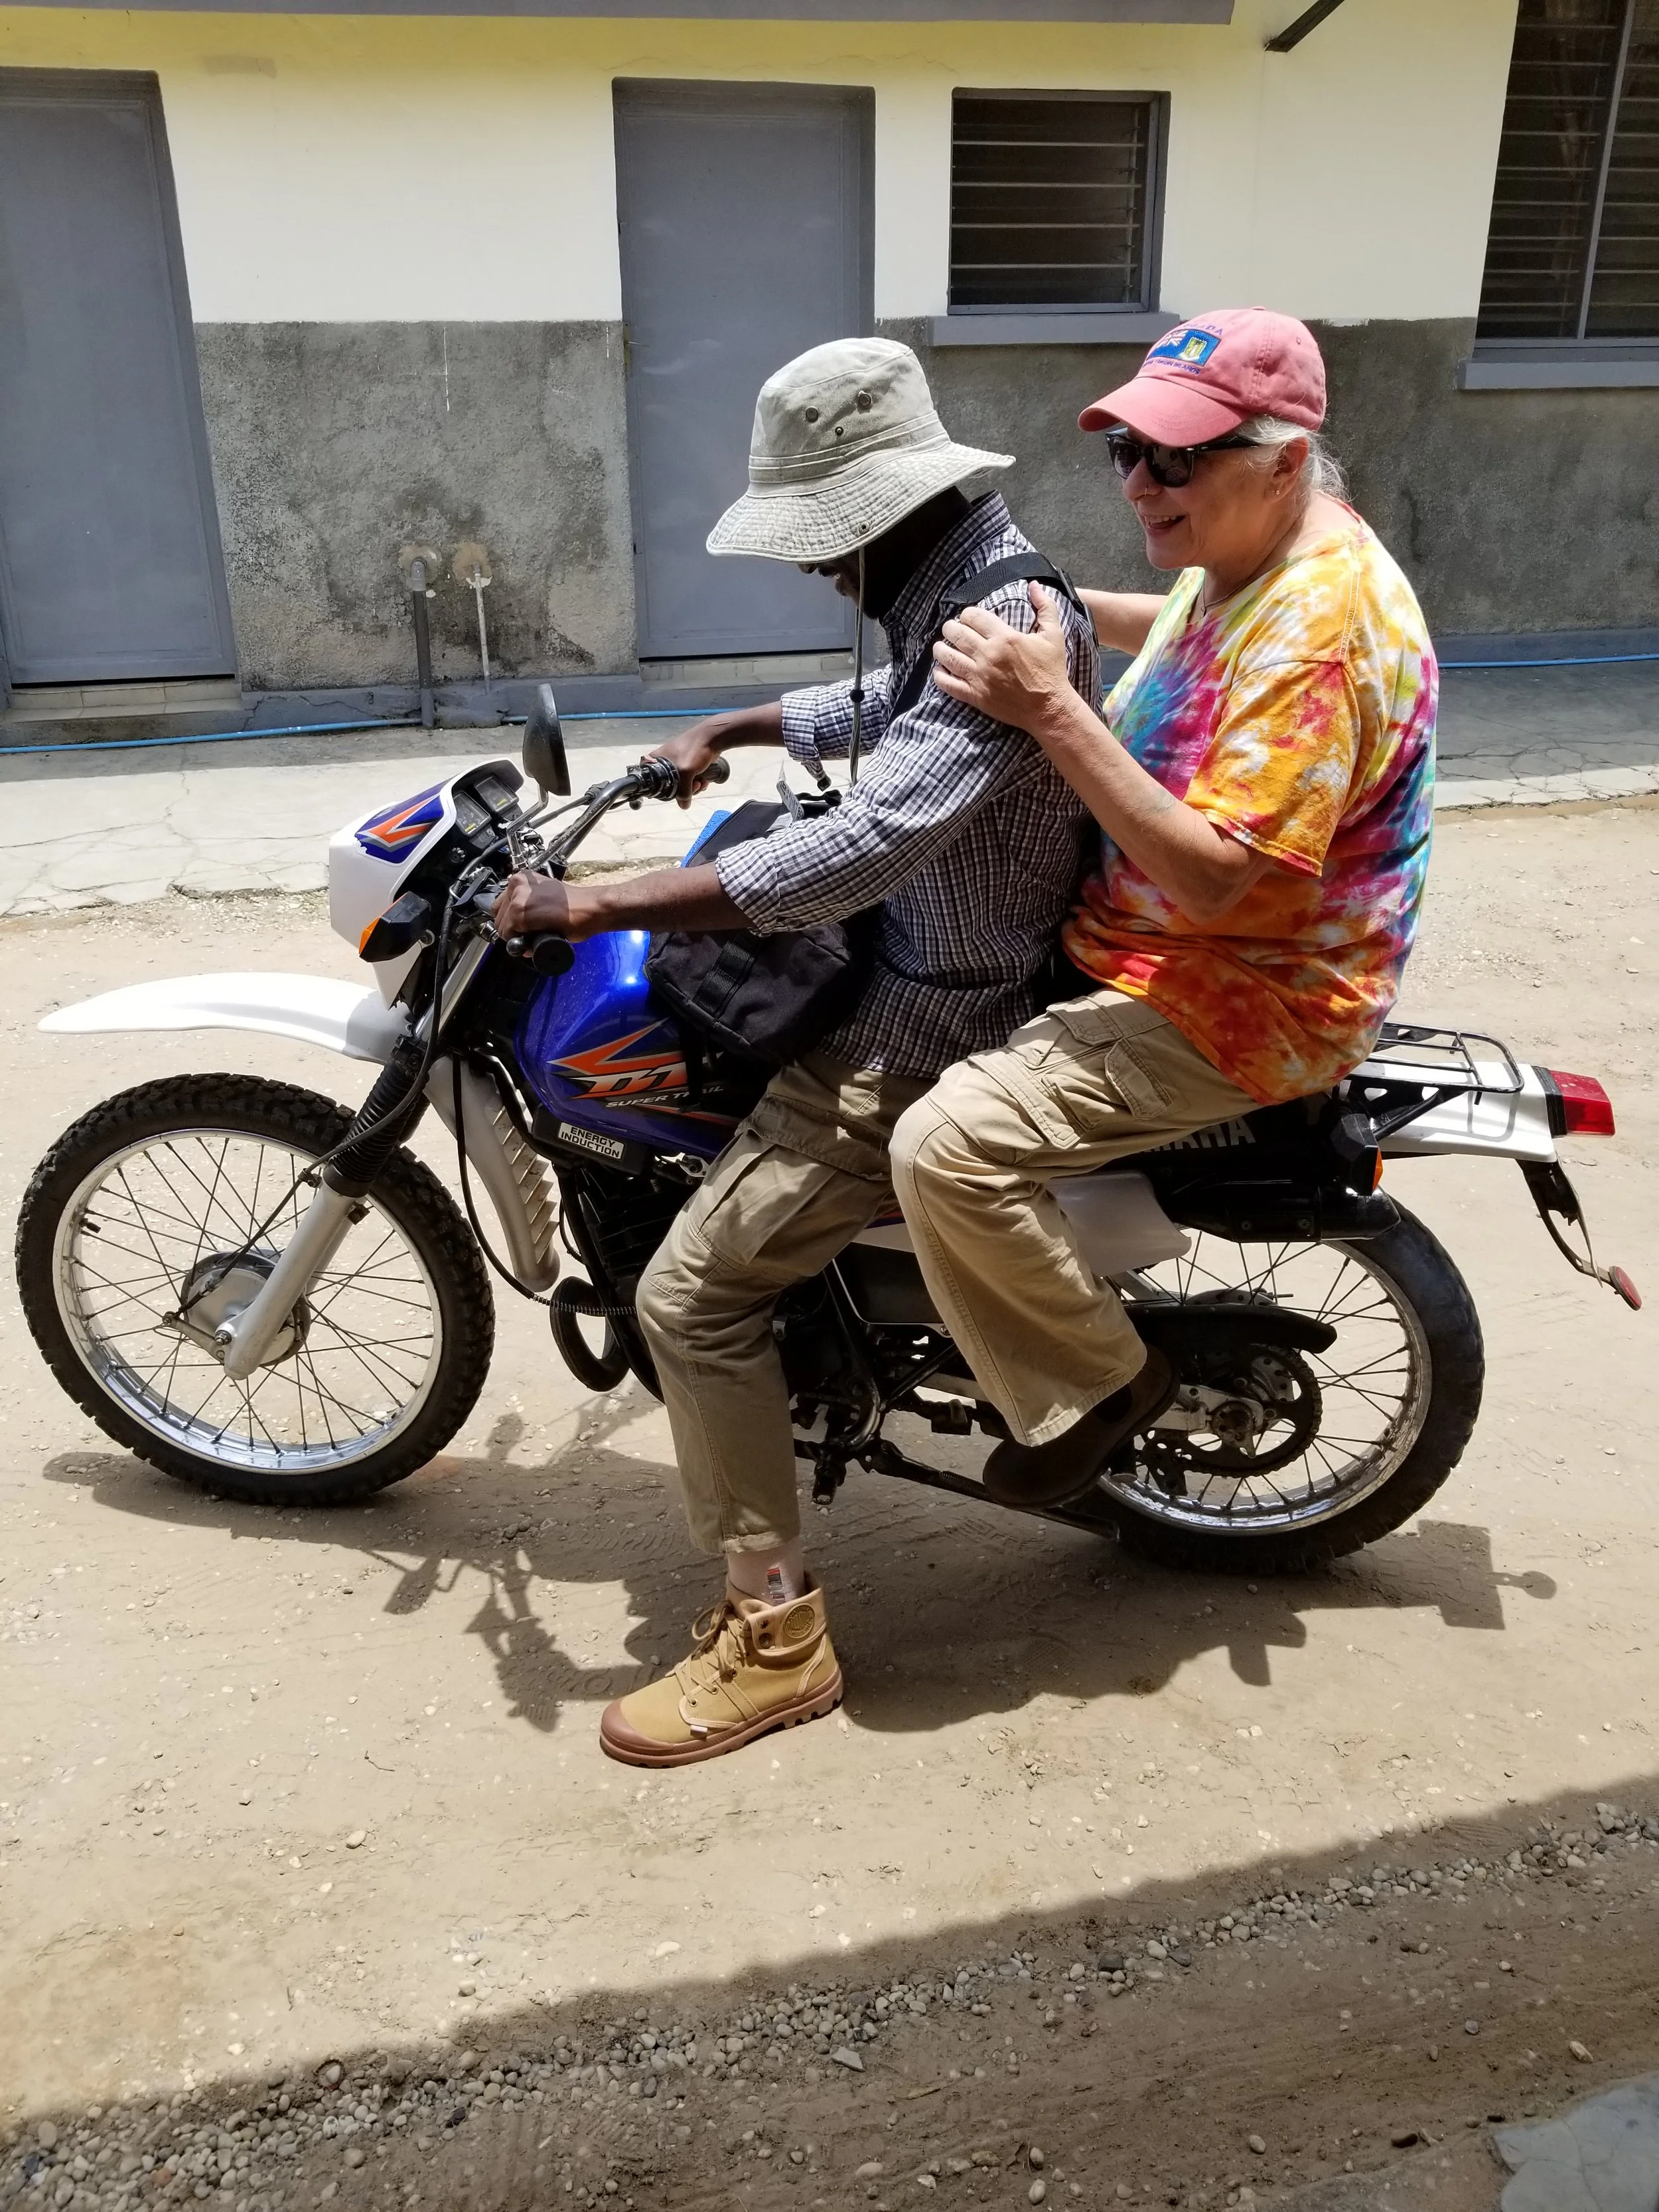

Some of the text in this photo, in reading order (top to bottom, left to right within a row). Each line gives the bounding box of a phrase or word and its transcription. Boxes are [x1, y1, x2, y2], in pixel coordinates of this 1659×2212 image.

[605, 1095, 669, 1108] SUPER
[561, 1131, 620, 1158] INDUCTION
[570, 1126, 616, 1148] ENERGY
